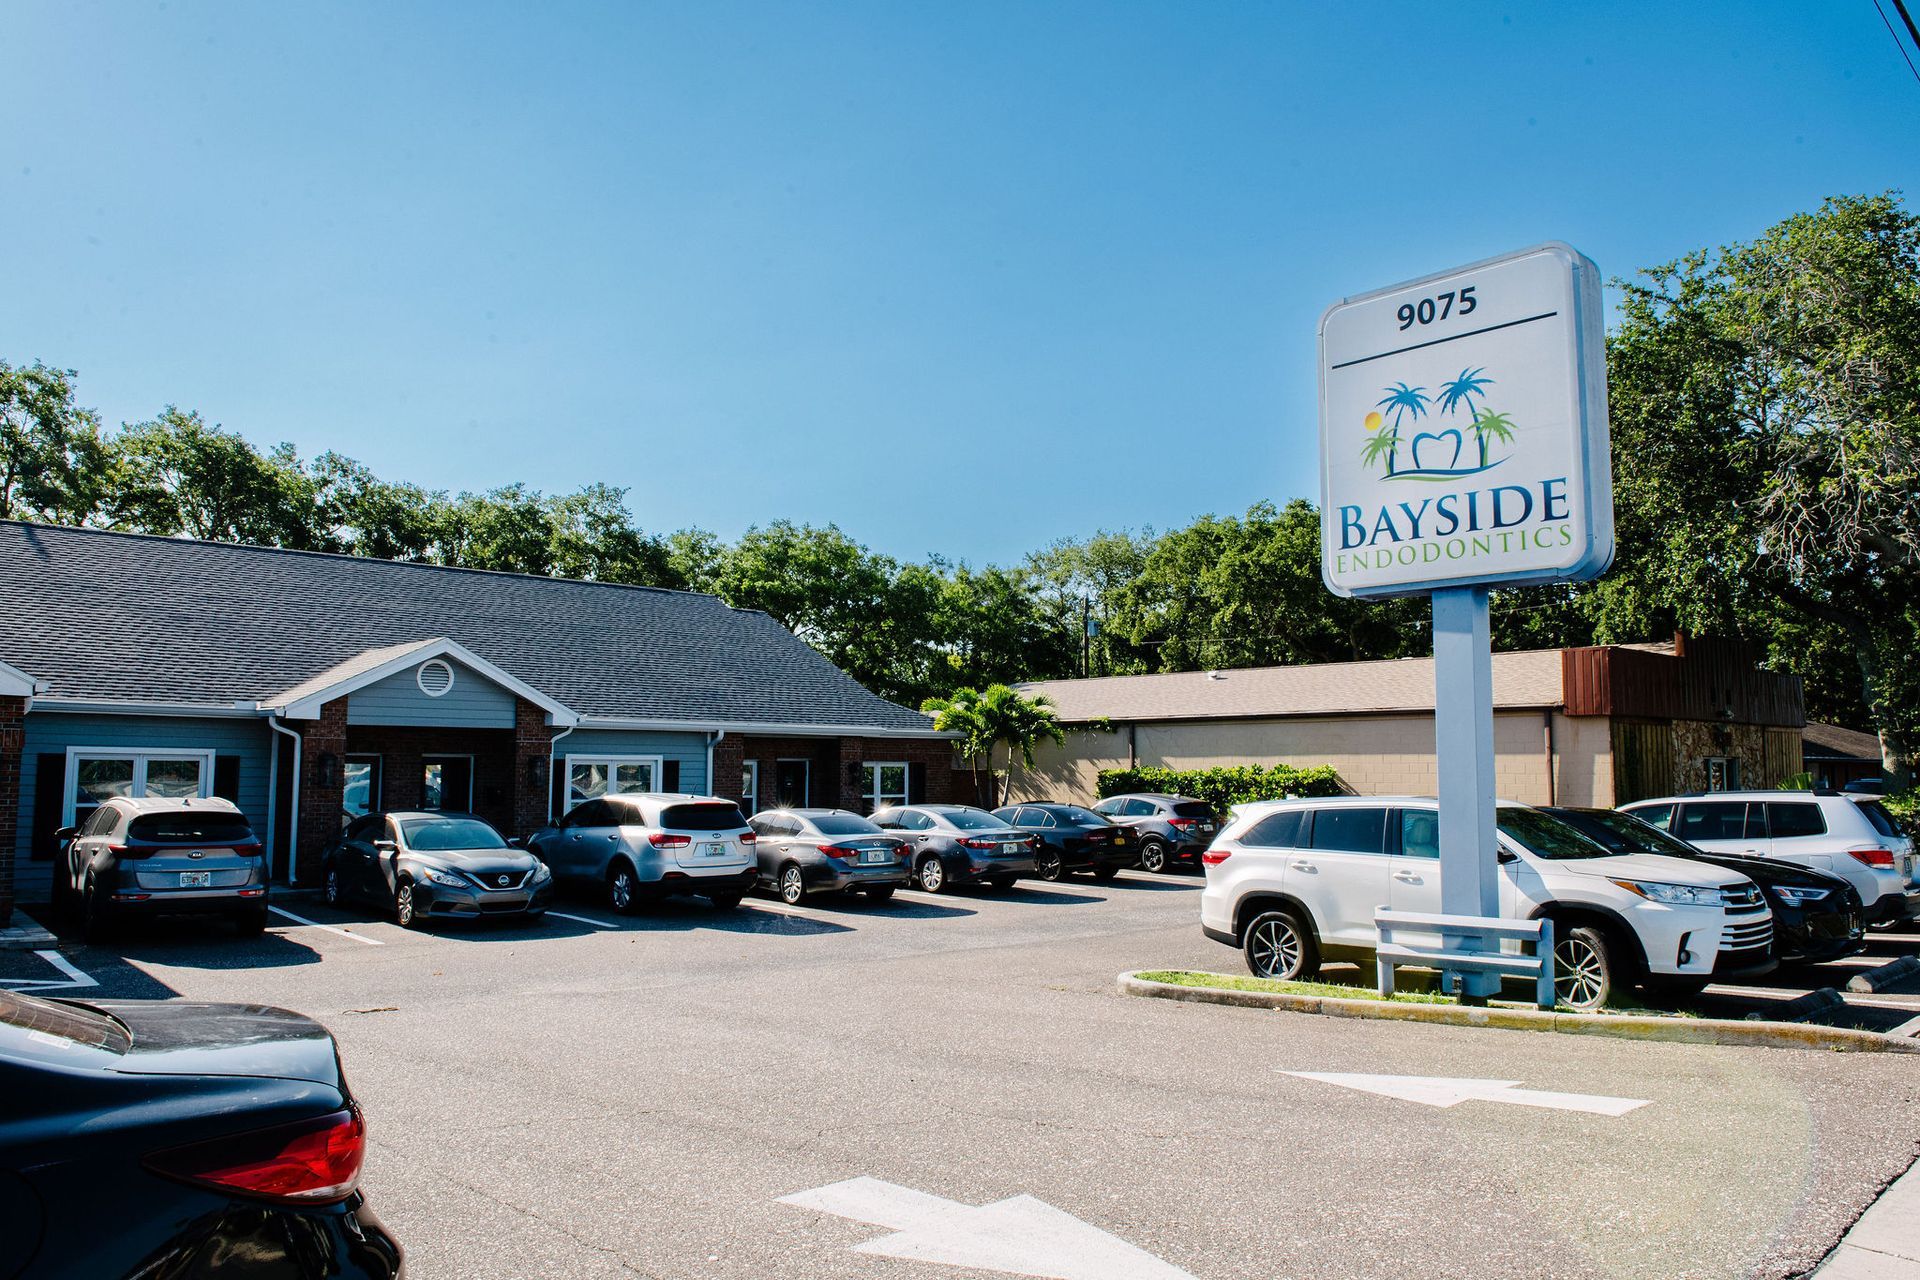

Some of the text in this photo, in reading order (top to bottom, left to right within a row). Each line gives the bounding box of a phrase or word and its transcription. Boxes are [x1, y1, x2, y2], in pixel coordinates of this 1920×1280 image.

[1397, 286, 1477, 331] 9075
[1336, 477, 1570, 550] BAYSIDE
[1337, 524, 1572, 574] ENDODONTICS
